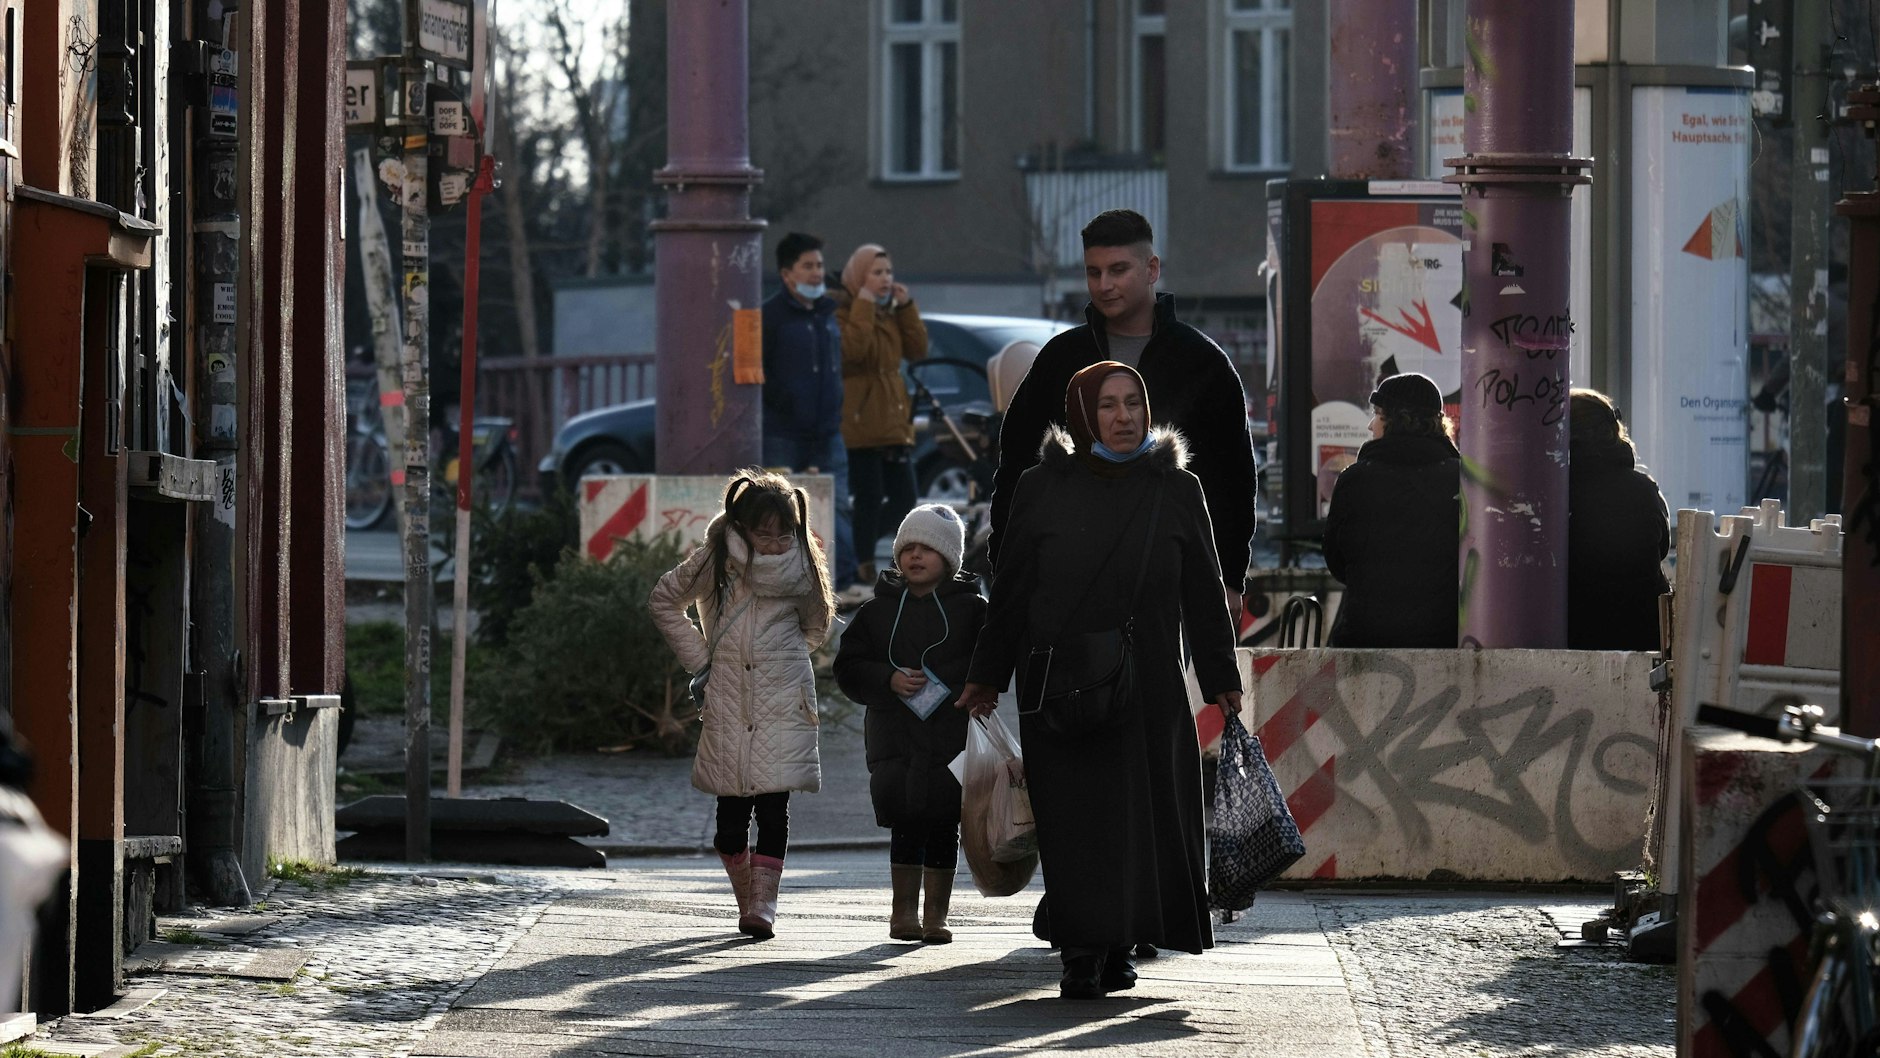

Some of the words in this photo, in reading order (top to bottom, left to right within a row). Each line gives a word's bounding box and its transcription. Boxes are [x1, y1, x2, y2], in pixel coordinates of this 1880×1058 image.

[439, 107, 457, 115] DOPE
[1682, 113, 1709, 128] Egal,
[439, 122, 458, 131] DOPE
[1680, 397, 1700, 408] Den
